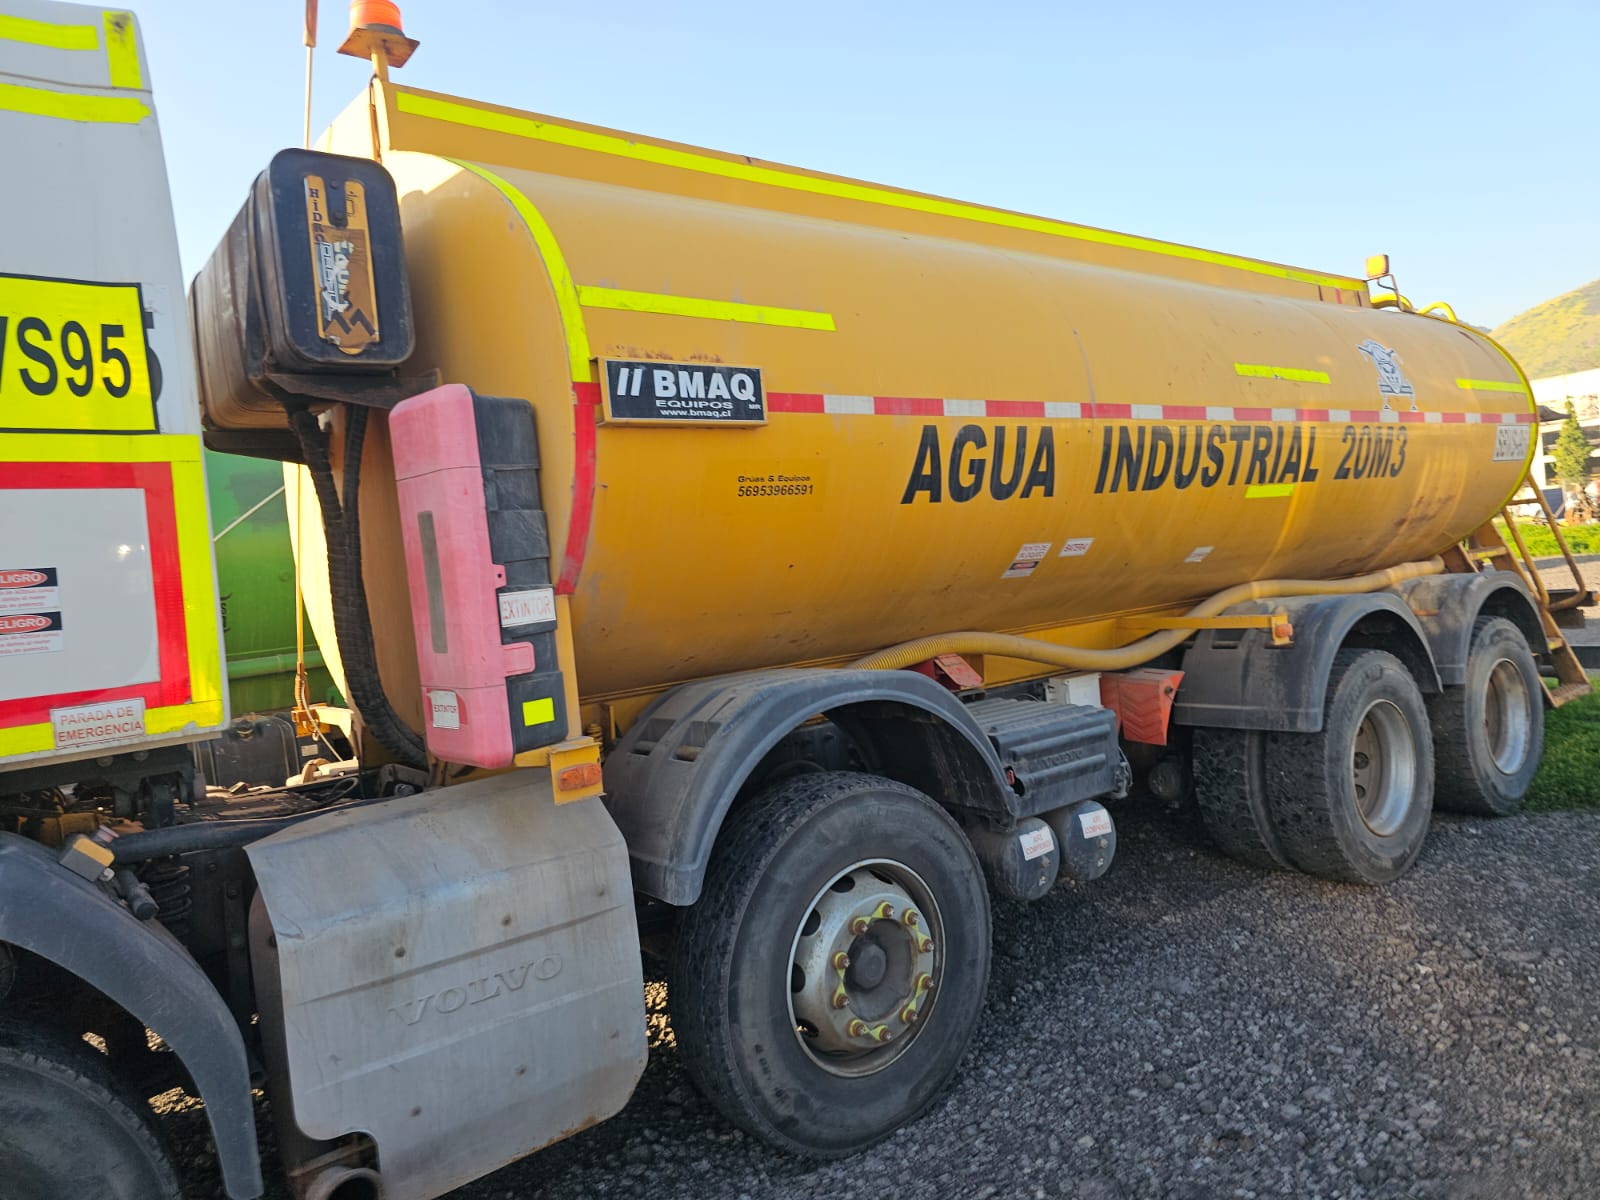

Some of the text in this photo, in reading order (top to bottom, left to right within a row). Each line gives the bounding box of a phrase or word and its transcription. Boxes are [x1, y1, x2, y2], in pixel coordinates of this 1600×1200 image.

[0, 316, 131, 398] S95
[653, 368, 756, 402] BMAQ
[656, 399, 734, 409] EQUIPOS
[660, 408, 732, 418] www.bmaq.cl
[901, 424, 1408, 504] AGUA INDUSTRIAL 20M3
[737, 484, 814, 497] 56953966591
[60, 706, 134, 726] PARADA DE
[57, 720, 143, 742] EMERGENCIA
[388, 953, 563, 1027] VOLVO
